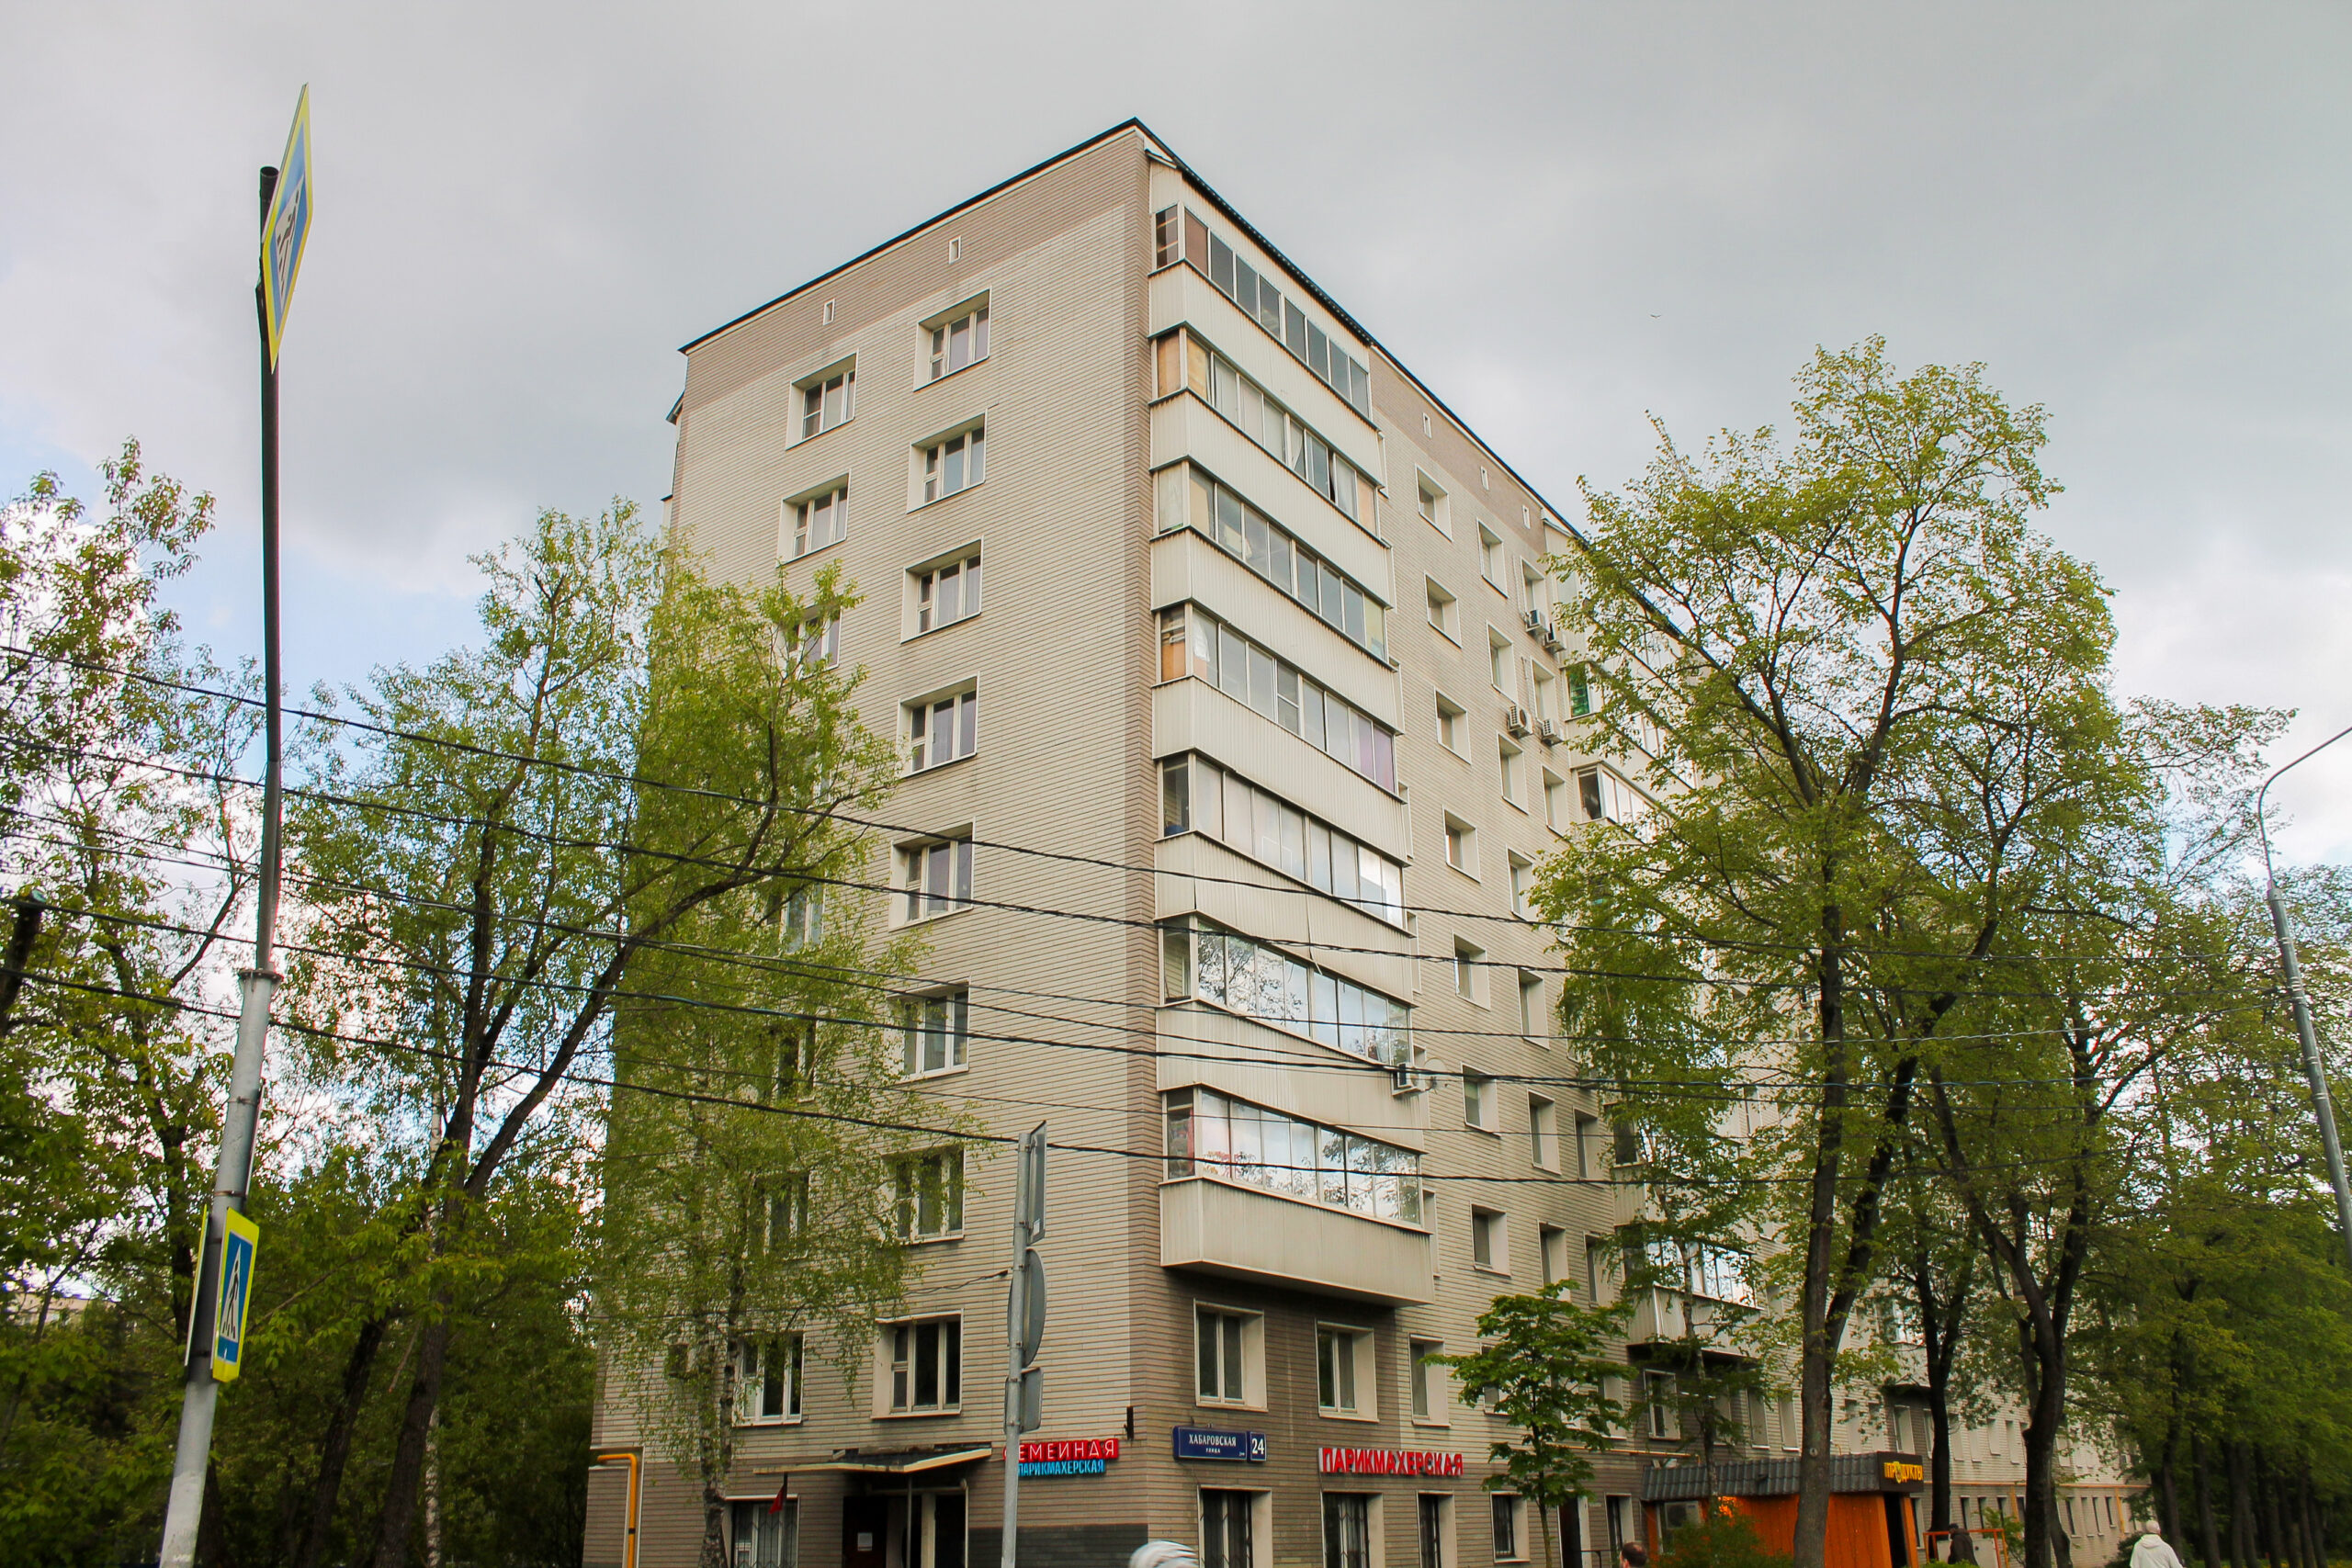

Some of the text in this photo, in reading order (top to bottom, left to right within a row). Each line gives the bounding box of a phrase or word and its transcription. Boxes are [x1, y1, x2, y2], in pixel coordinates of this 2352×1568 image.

[1189, 1434, 1237, 1447] ХАБАРОВСКАЯ
[1251, 1438, 1264, 1455] 24
[1018, 1459, 1106, 1477] ПАРИКМАХЕРСКАЯ
[1319, 1448, 1464, 1476] ПАРИКМАХЕРСКАЯ
[1884, 1461, 1923, 1483] ПРОДУКТЫ
